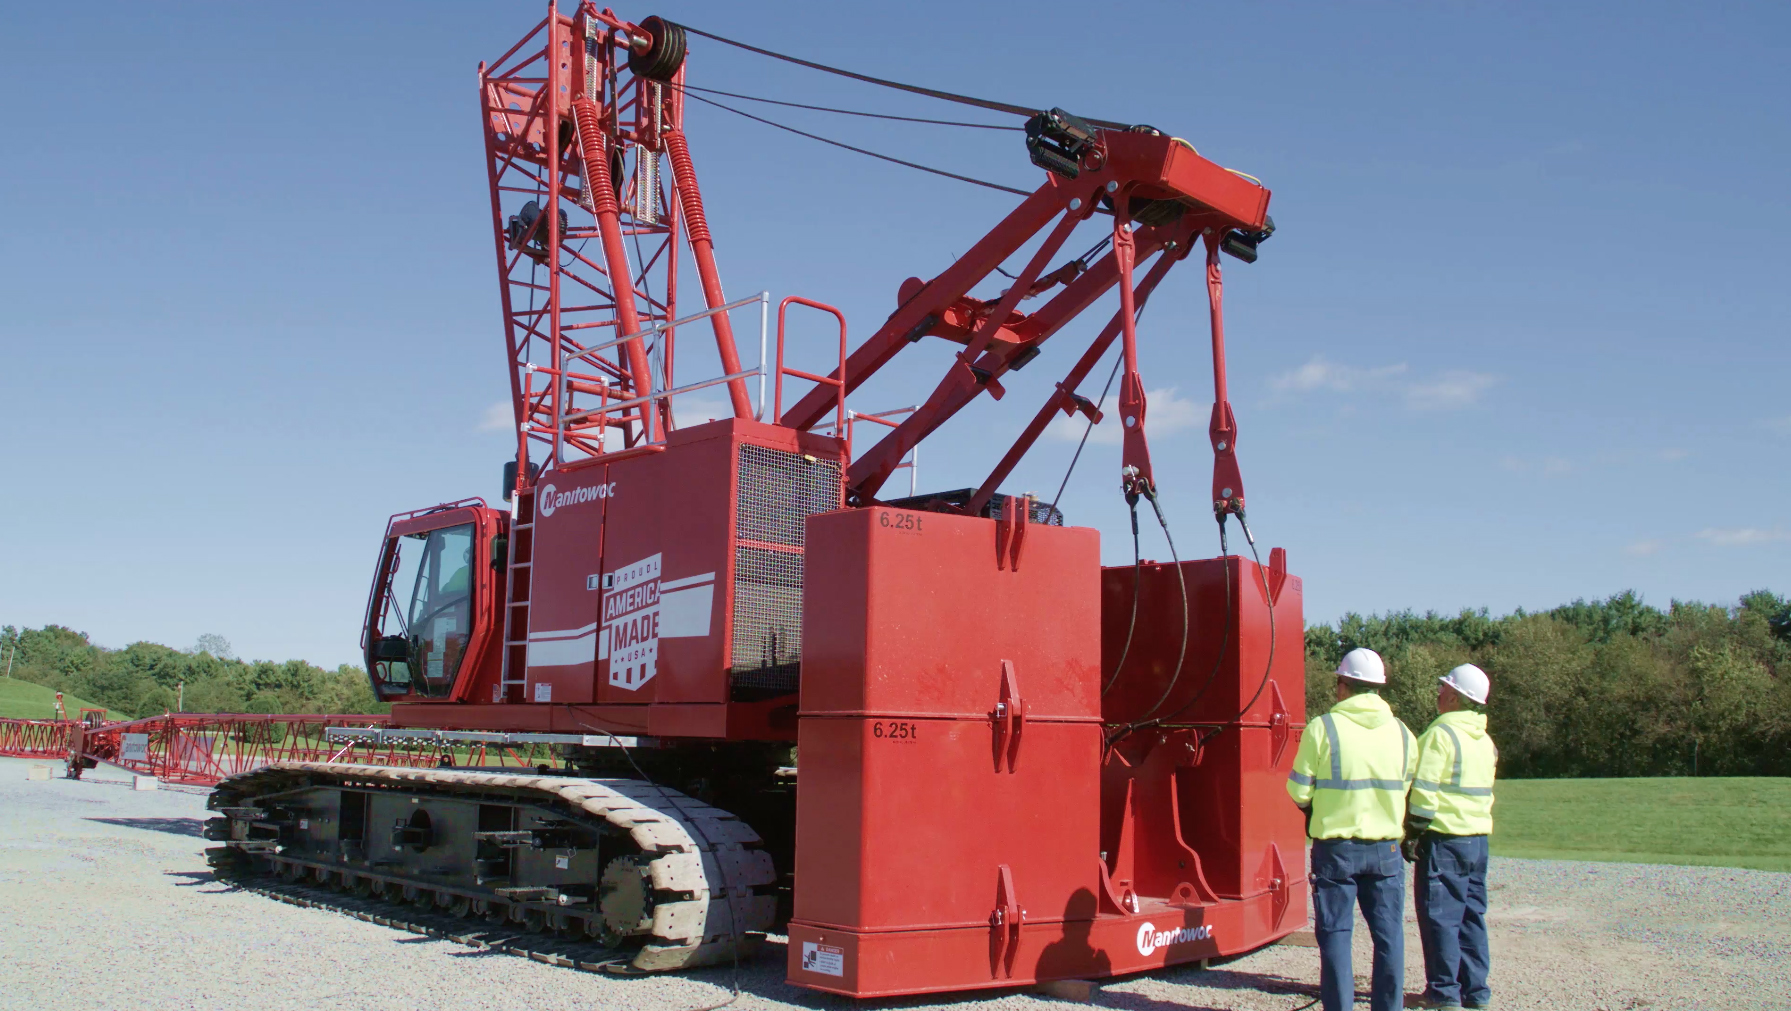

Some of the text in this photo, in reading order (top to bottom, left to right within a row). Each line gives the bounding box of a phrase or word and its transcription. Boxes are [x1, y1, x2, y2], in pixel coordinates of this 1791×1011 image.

[540, 482, 616, 517] Manitowoc
[614, 610, 660, 652] MADE
[627, 648, 646, 662] USA
[1136, 922, 1213, 957] Manitowoc
